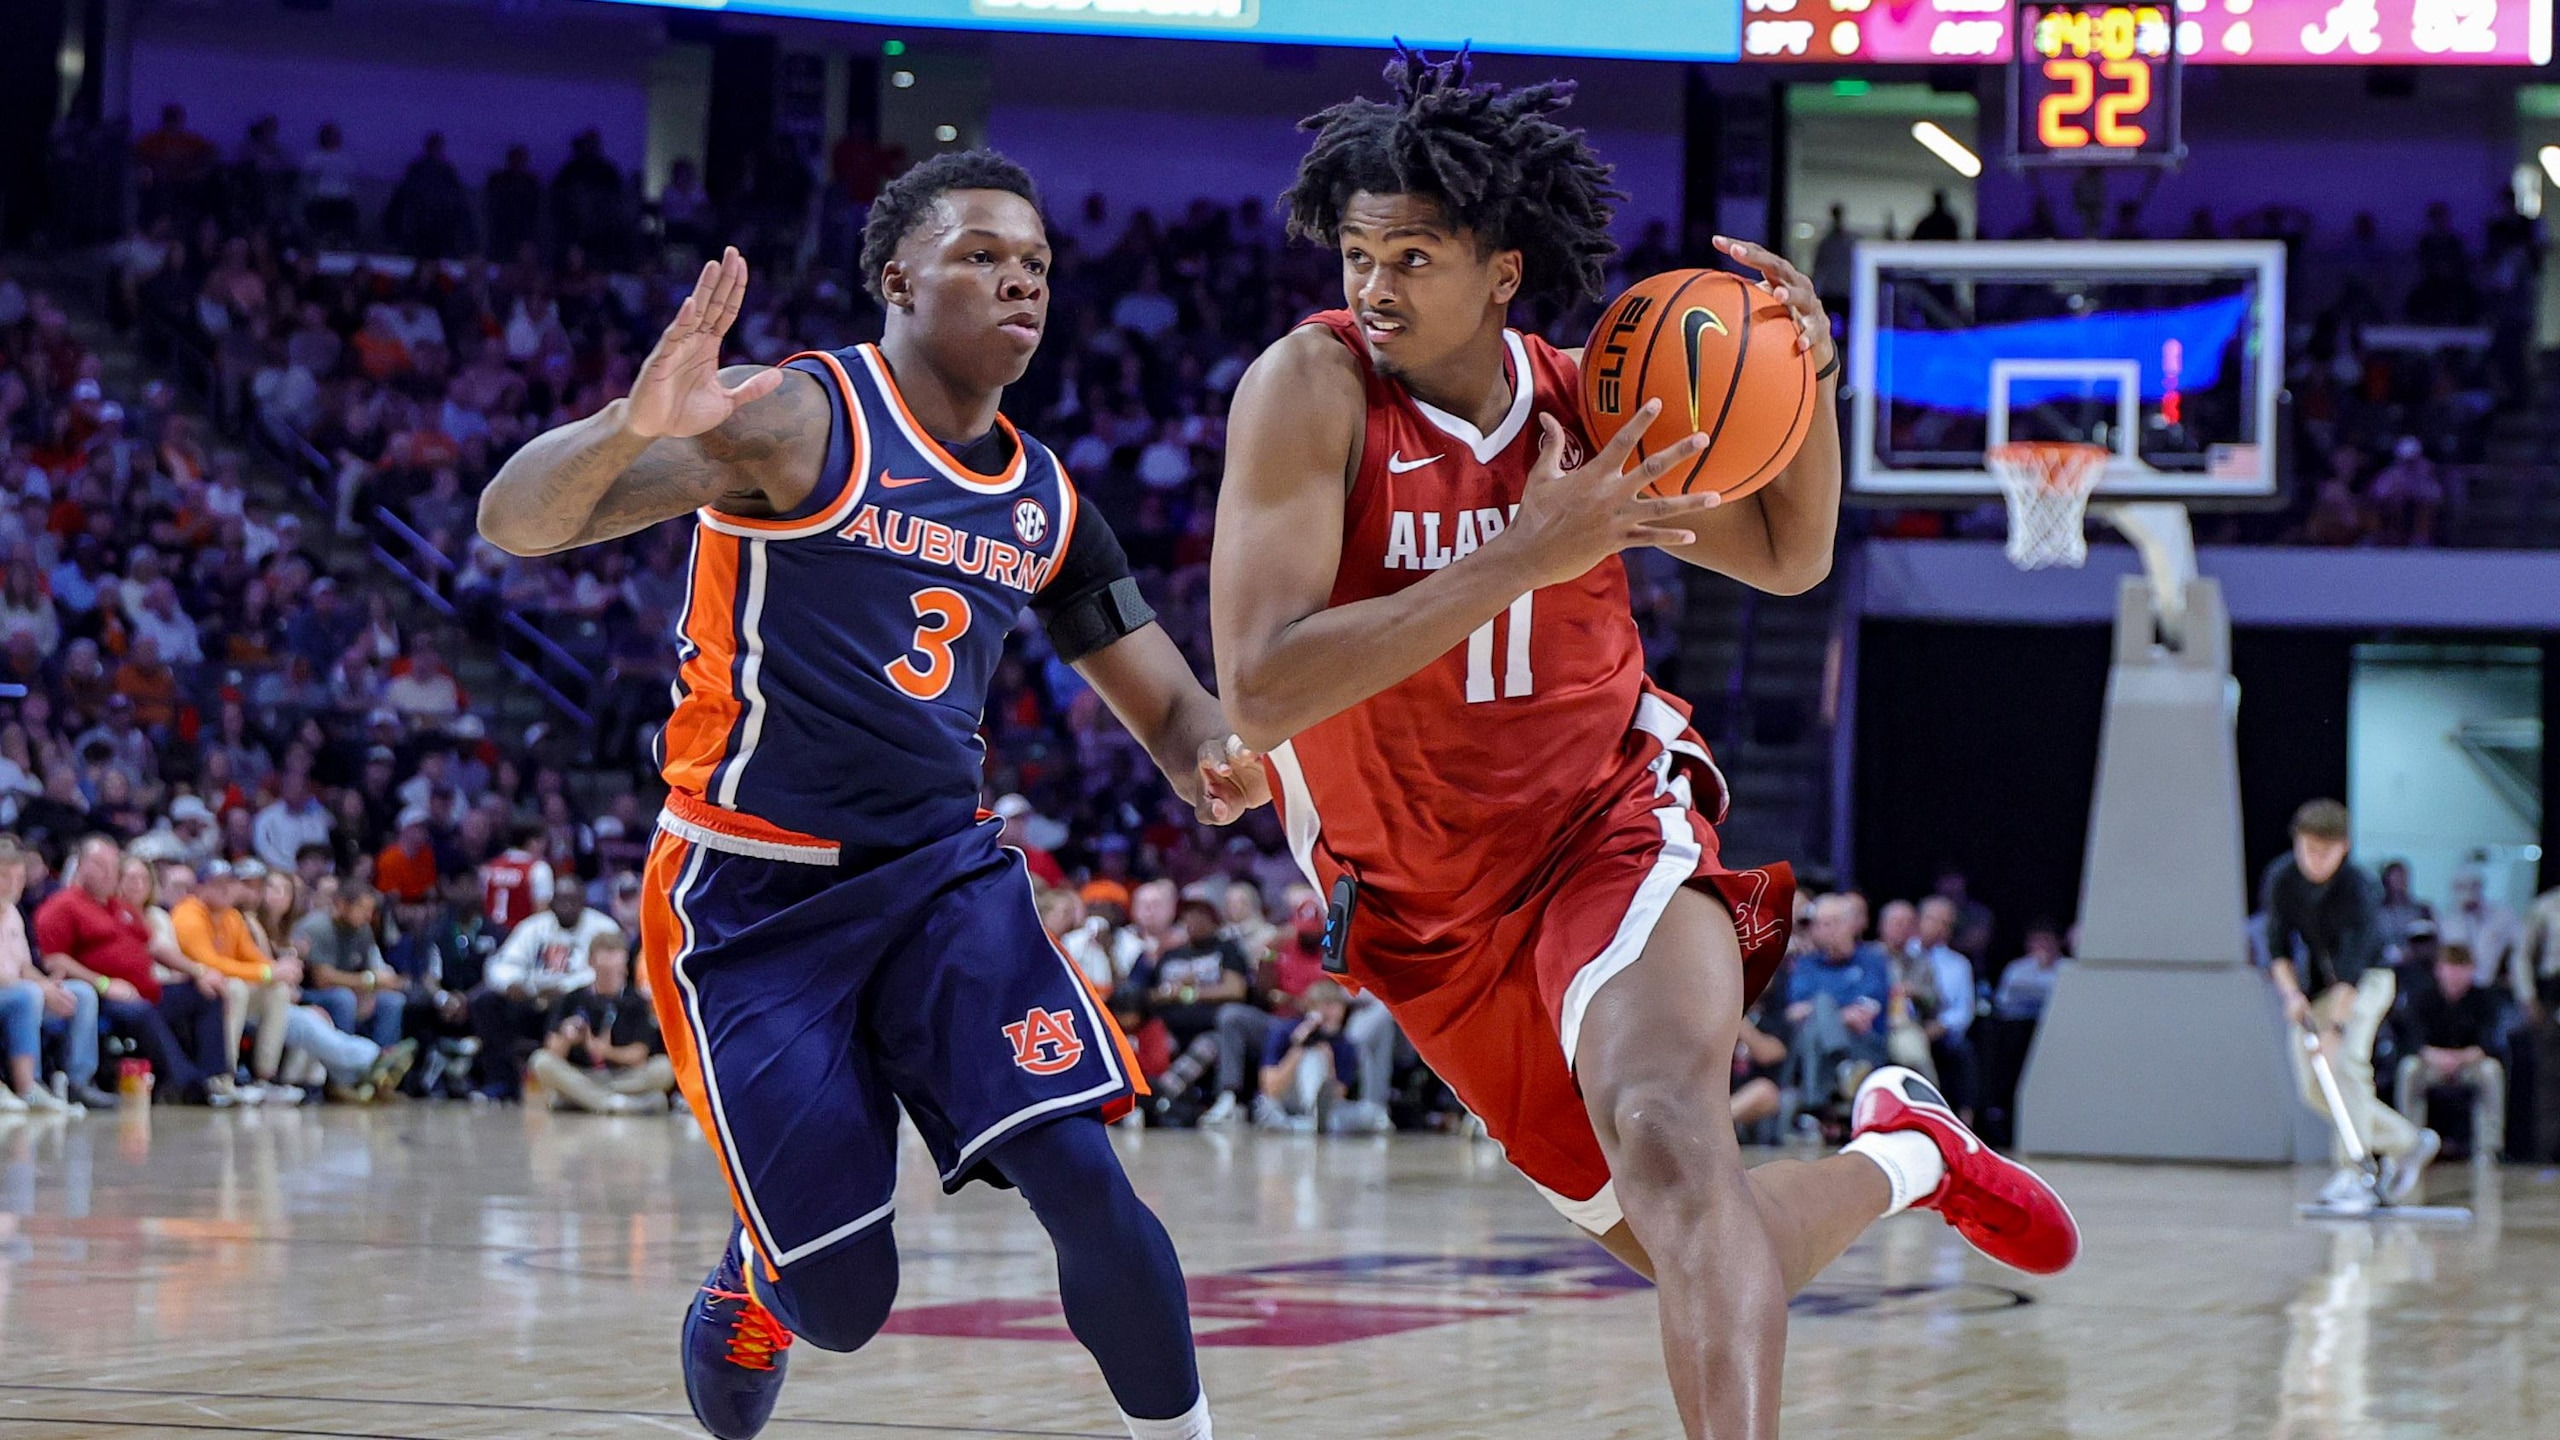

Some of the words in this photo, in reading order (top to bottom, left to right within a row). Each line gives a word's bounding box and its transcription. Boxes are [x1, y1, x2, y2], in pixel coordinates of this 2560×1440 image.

[2038, 59, 2152, 147] 22
[1598, 297, 1654, 414] ELITE
[837, 503, 1050, 594] AUBURN
[1015, 501, 1047, 543] SEC
[883, 586, 972, 701] 3
[1466, 590, 1534, 703] 11
